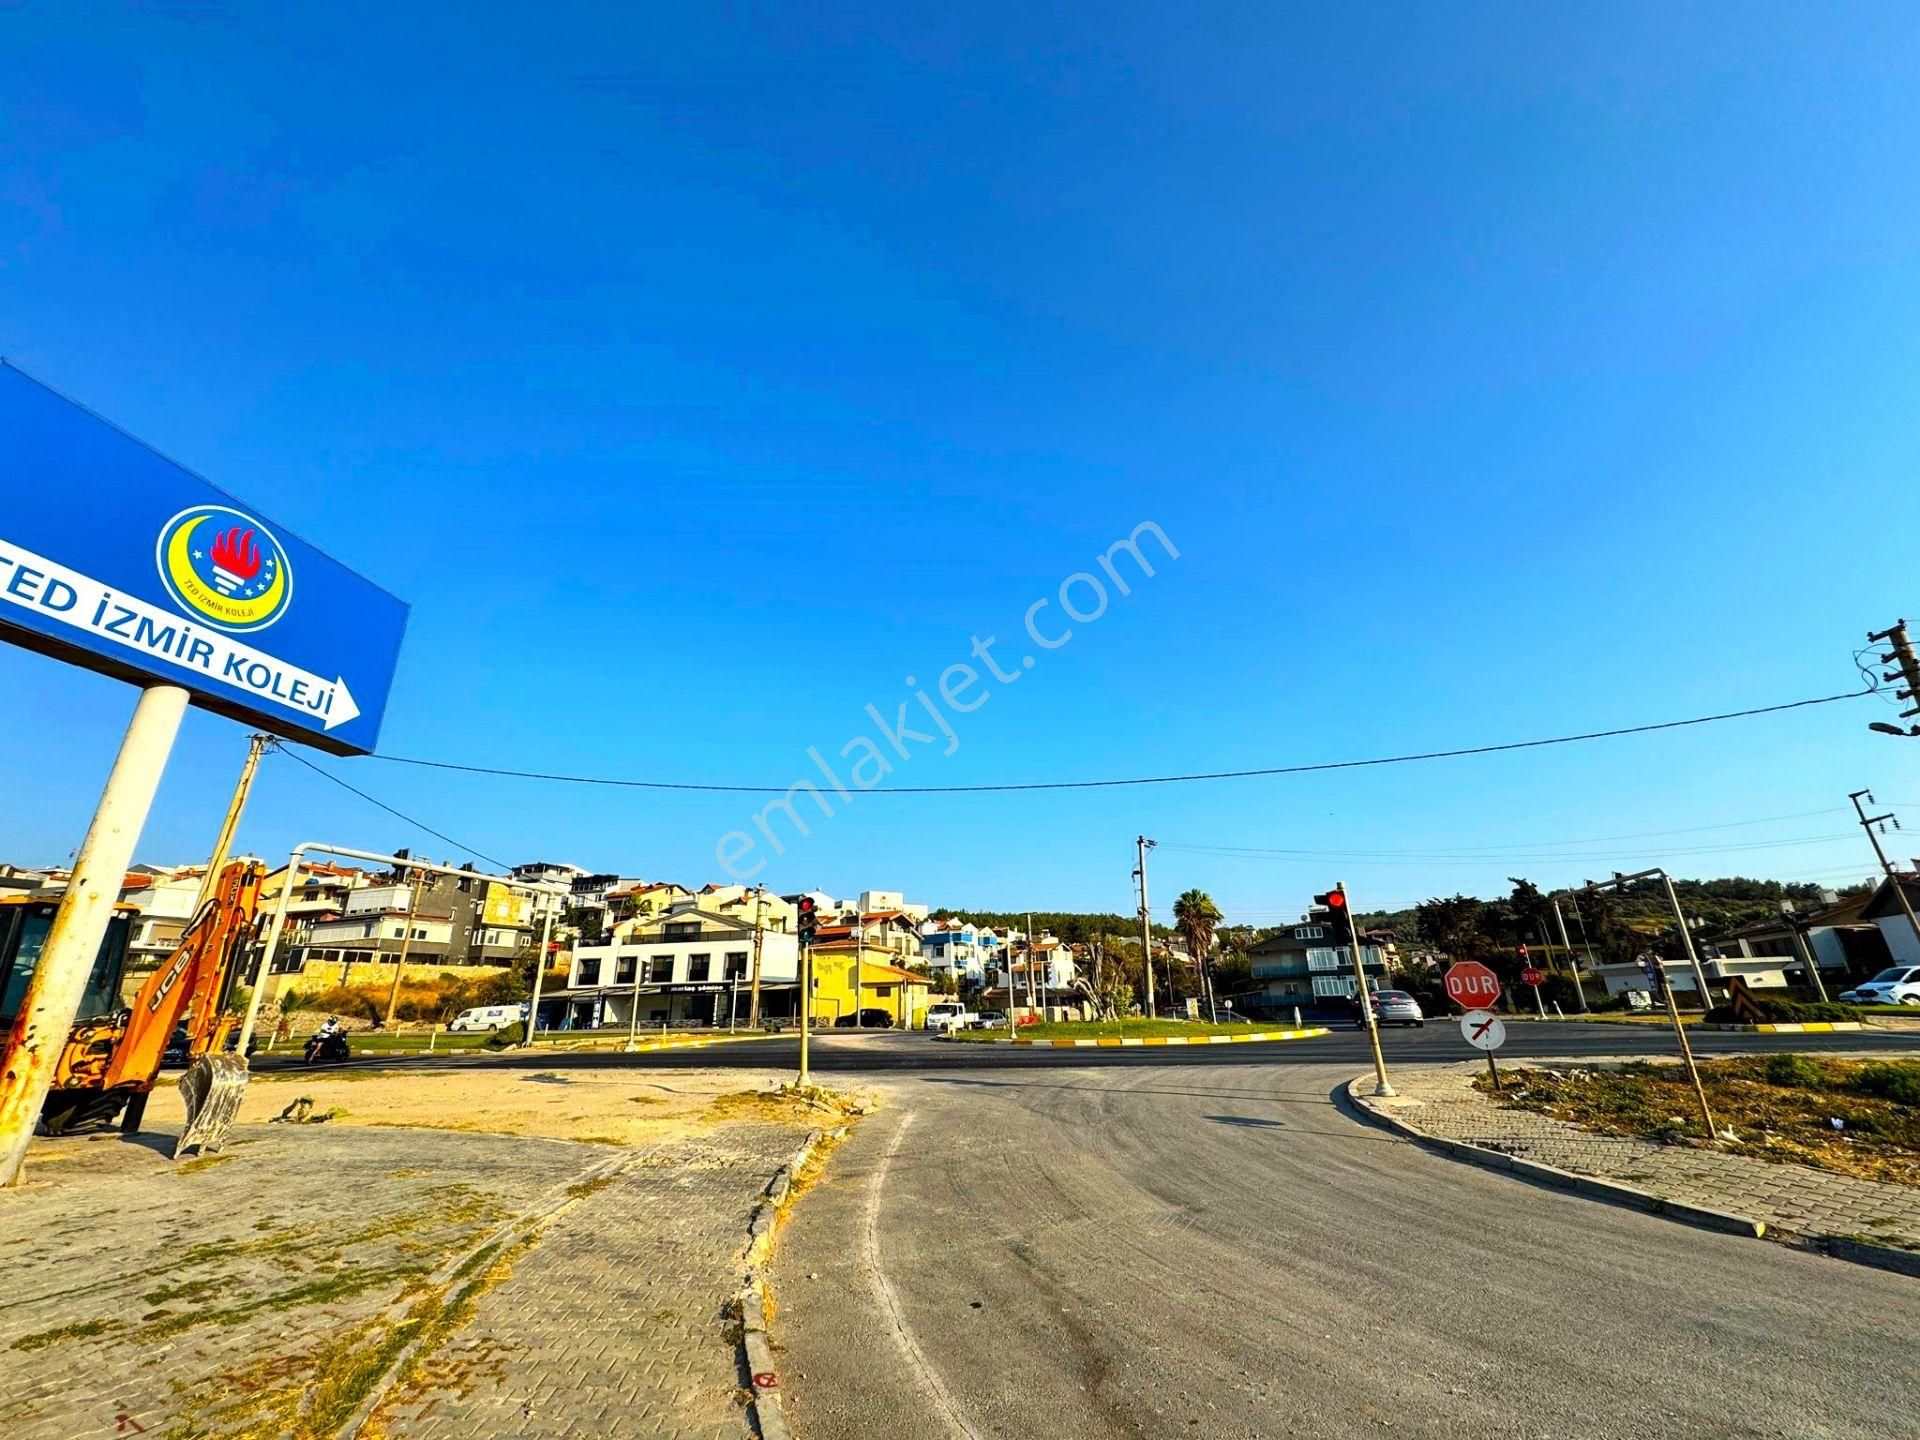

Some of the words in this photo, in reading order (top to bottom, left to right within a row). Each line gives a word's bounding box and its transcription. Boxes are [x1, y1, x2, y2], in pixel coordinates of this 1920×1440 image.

[184, 579, 199, 595] TED
[91, 592, 214, 669] İZMİR
[223, 652, 335, 715] KOLEJİ
[151, 950, 190, 1011] JCB
[1449, 976, 1495, 994] DUR
